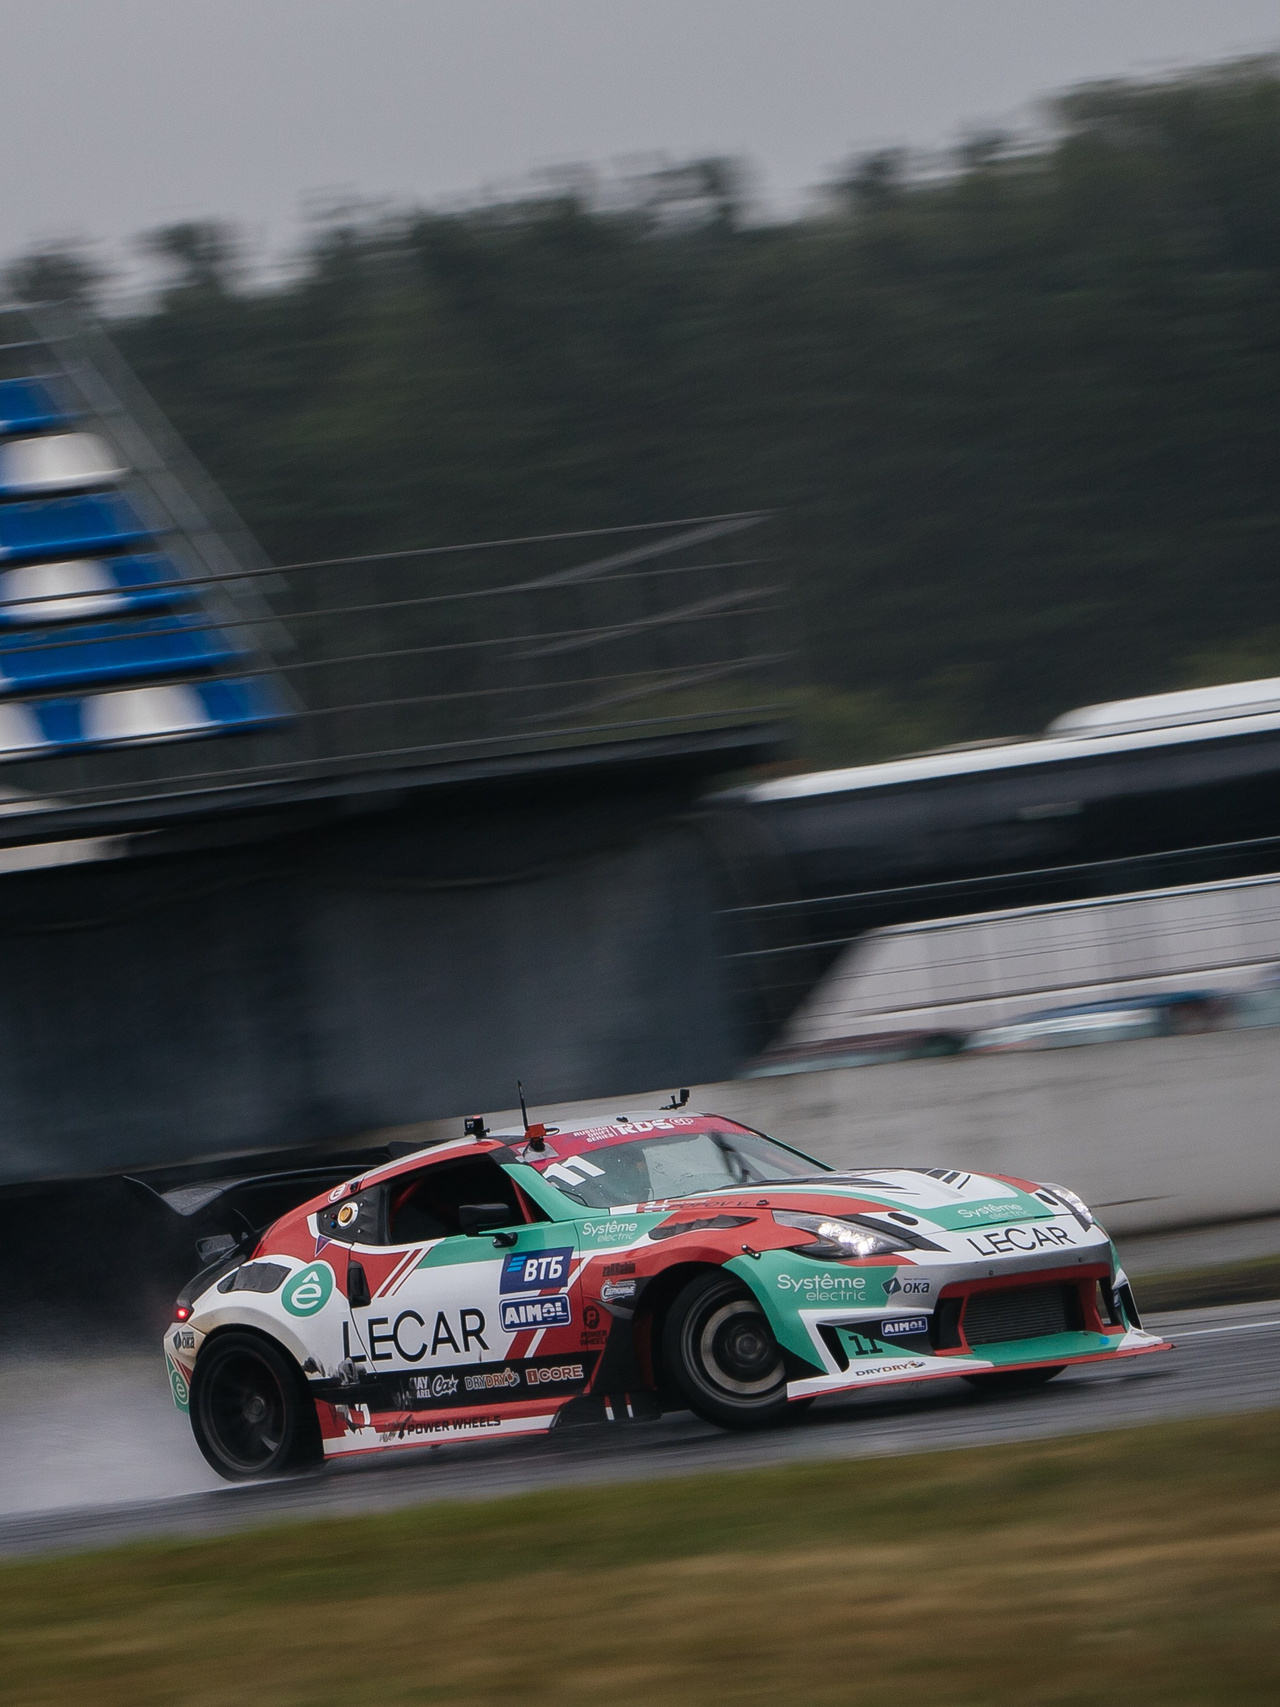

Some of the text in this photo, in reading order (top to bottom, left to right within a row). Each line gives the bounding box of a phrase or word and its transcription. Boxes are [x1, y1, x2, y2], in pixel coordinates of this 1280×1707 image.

[573, 1126, 610, 1138] RUSSIAN
[586, 1132, 615, 1143] SERIES
[588, 1130, 612, 1139] DRIFT
[542, 1155, 606, 1187] 11
[957, 1203, 1023, 1219] Systême
[582, 1220, 638, 1236] Systême
[597, 1231, 635, 1243] electric
[966, 1227, 1077, 1257] LECAR
[524, 1256, 564, 1282] ВТБ
[777, 1273, 866, 1293] Systême
[806, 1288, 866, 1301] electric
[505, 1302, 568, 1325] AIMOL
[884, 1319, 925, 1333] AIMOL
[342, 1308, 490, 1363] LECAR
[848, 1335, 884, 1356] 11
[407, 1415, 501, 1436] POWER WHEELS
